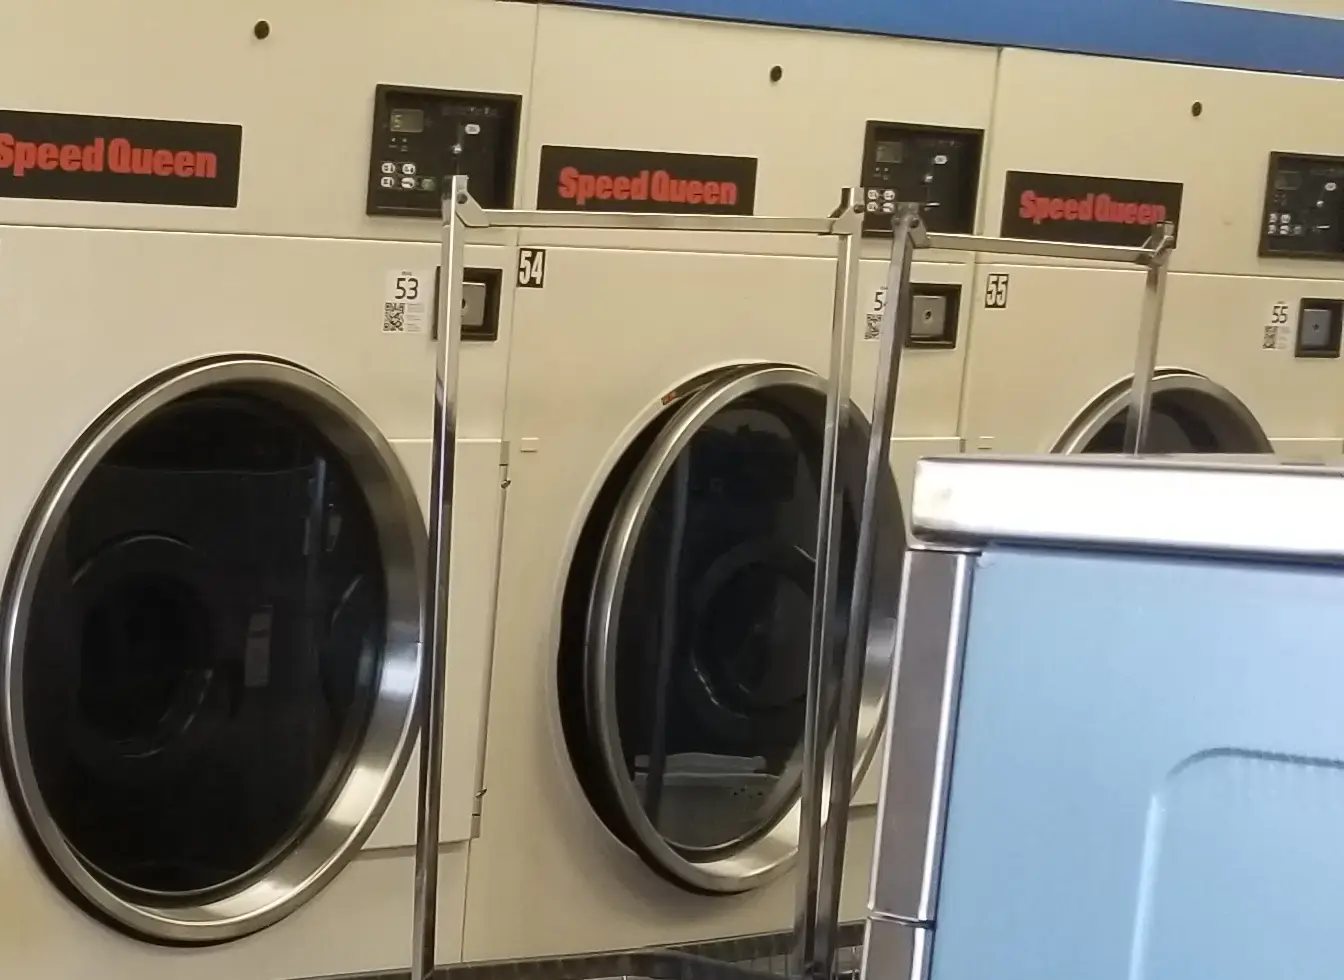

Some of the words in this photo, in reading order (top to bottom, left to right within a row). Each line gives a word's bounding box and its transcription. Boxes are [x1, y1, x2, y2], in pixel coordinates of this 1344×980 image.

[108, 137, 217, 178] Queen
[558, 166, 650, 206] Speed
[650, 169, 738, 205] Queen
[1019, 189, 1095, 225] Speed
[1094, 193, 1167, 225] Queen
[519, 250, 544, 285] 54
[394, 277, 419, 300] 53
[986, 275, 1007, 306] 55
[1272, 305, 1288, 323] 55
